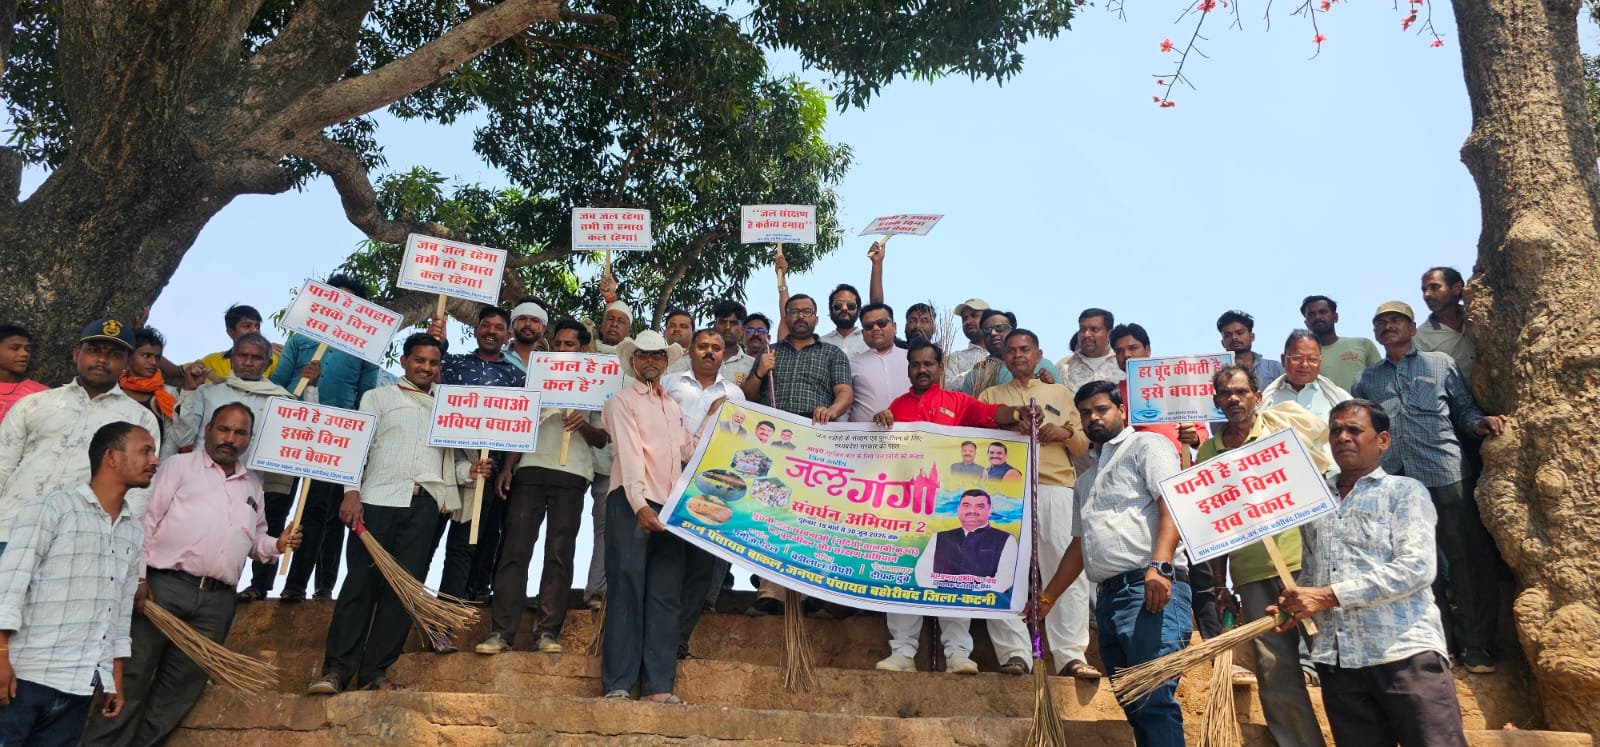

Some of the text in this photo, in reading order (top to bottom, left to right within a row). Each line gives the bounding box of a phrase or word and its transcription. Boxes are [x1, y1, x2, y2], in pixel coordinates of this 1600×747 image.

[622, 212, 644, 220] रहेगा
[745, 220, 753, 229] है
[755, 219, 779, 229] कर्तव्य
[779, 208, 808, 218] संरक्षण
[580, 222, 643, 231] तभी तो हमारा
[417, 240, 498, 263] जब जल रहेगा
[415, 254, 494, 277] तभी तो हमारा
[420, 269, 483, 289] कल रहेगा।
[308, 284, 396, 327] पानी है उपहार
[310, 302, 378, 336] इसके बिना
[305, 317, 330, 332] सब
[332, 325, 368, 349] बेकार
[585, 357, 598, 373] है
[602, 359, 620, 376] तो
[1138, 357, 1221, 381] हर बूंद कीमती है
[542, 378, 574, 392] कल
[1140, 383, 1165, 401] इसे
[447, 391, 480, 409] पानी
[483, 395, 530, 412] बचाओ
[277, 405, 367, 432] पानी है उपहार
[437, 412, 533, 434] भविष्य बचाओ
[281, 426, 351, 448] इसके बिना
[280, 445, 342, 467] सब बेकार
[1173, 441, 1289, 495] पानी है उपहार
[785, 456, 941, 515] जल गंगा
[1195, 467, 1288, 516] इसके बिना
[791, 500, 927, 533] संवर्धन अभियान 2
[1211, 491, 1296, 534] सब बेकार
[708, 529, 747, 554] पंचायत
[827, 576, 868, 595] पंचायत
[870, 585, 921, 601] बहोरीबंद
[864, 551, 898, 562] अभियान
